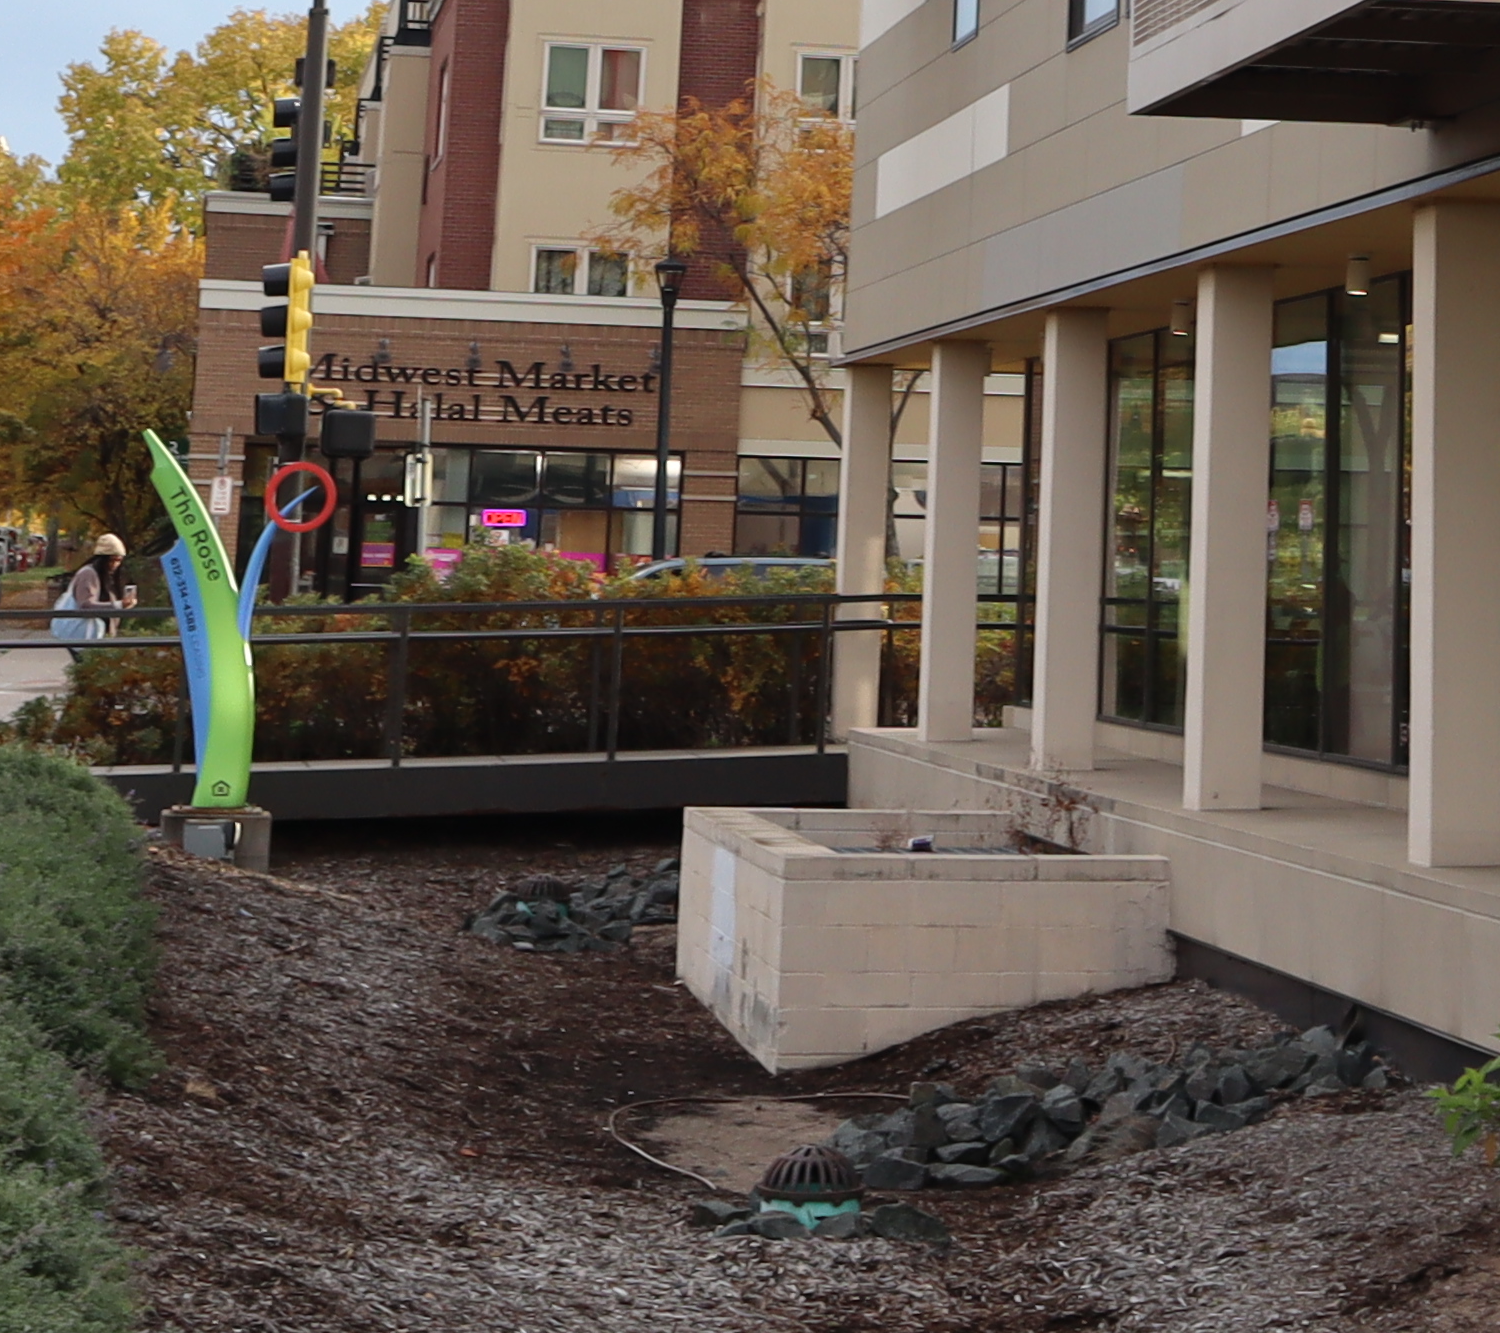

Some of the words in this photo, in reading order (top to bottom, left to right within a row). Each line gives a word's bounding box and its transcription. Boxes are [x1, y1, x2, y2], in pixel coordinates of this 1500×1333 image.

[495, 360, 656, 393] Market
[501, 395, 634, 427] Meats
[171, 486, 196, 526] The
[191, 530, 220, 581] Rose
[485, 513, 522, 524] OPEN
